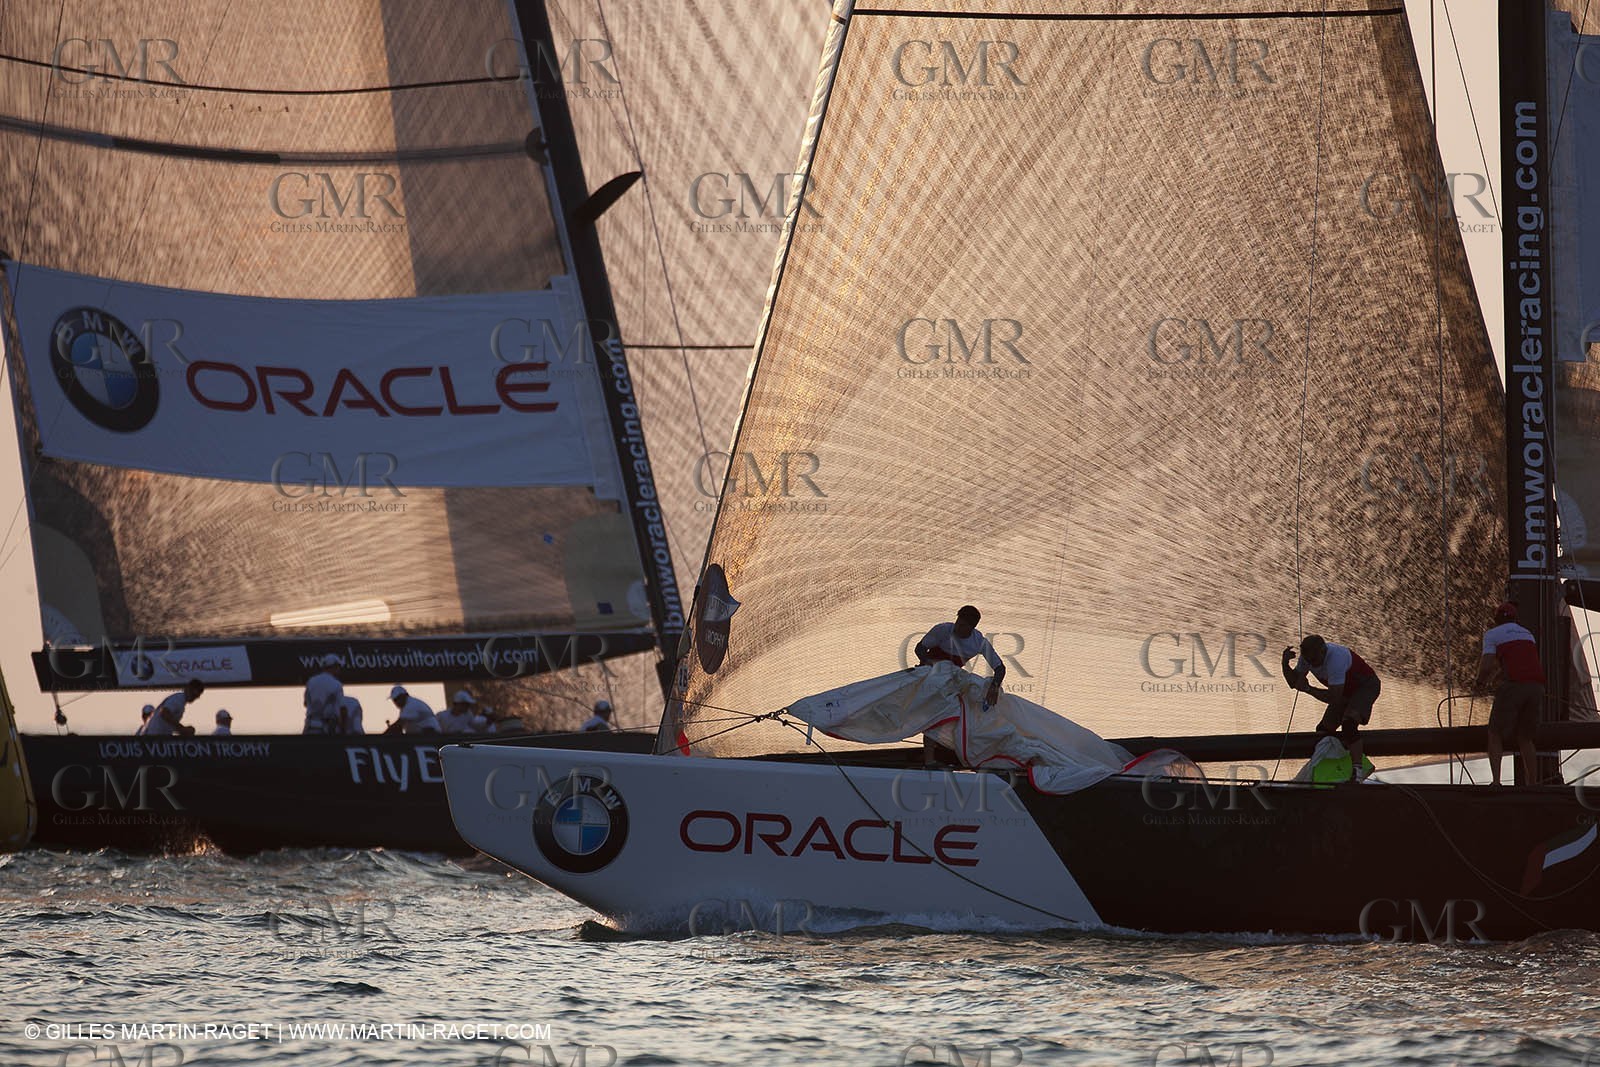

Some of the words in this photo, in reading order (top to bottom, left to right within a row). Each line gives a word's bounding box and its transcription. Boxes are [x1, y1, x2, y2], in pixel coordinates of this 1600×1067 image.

[1511, 101, 1546, 568] bmworacleracing.com
[186, 361, 559, 417] ORACLE
[611, 338, 684, 629] bmworacleracing.com
[100, 741, 143, 758] LOUIS
[146, 741, 211, 758] VUITTON
[215, 741, 270, 758] TROPHY
[345, 746, 408, 791] Fly
[545, 777, 622, 810] BMW
[680, 810, 980, 867] ORACLE
